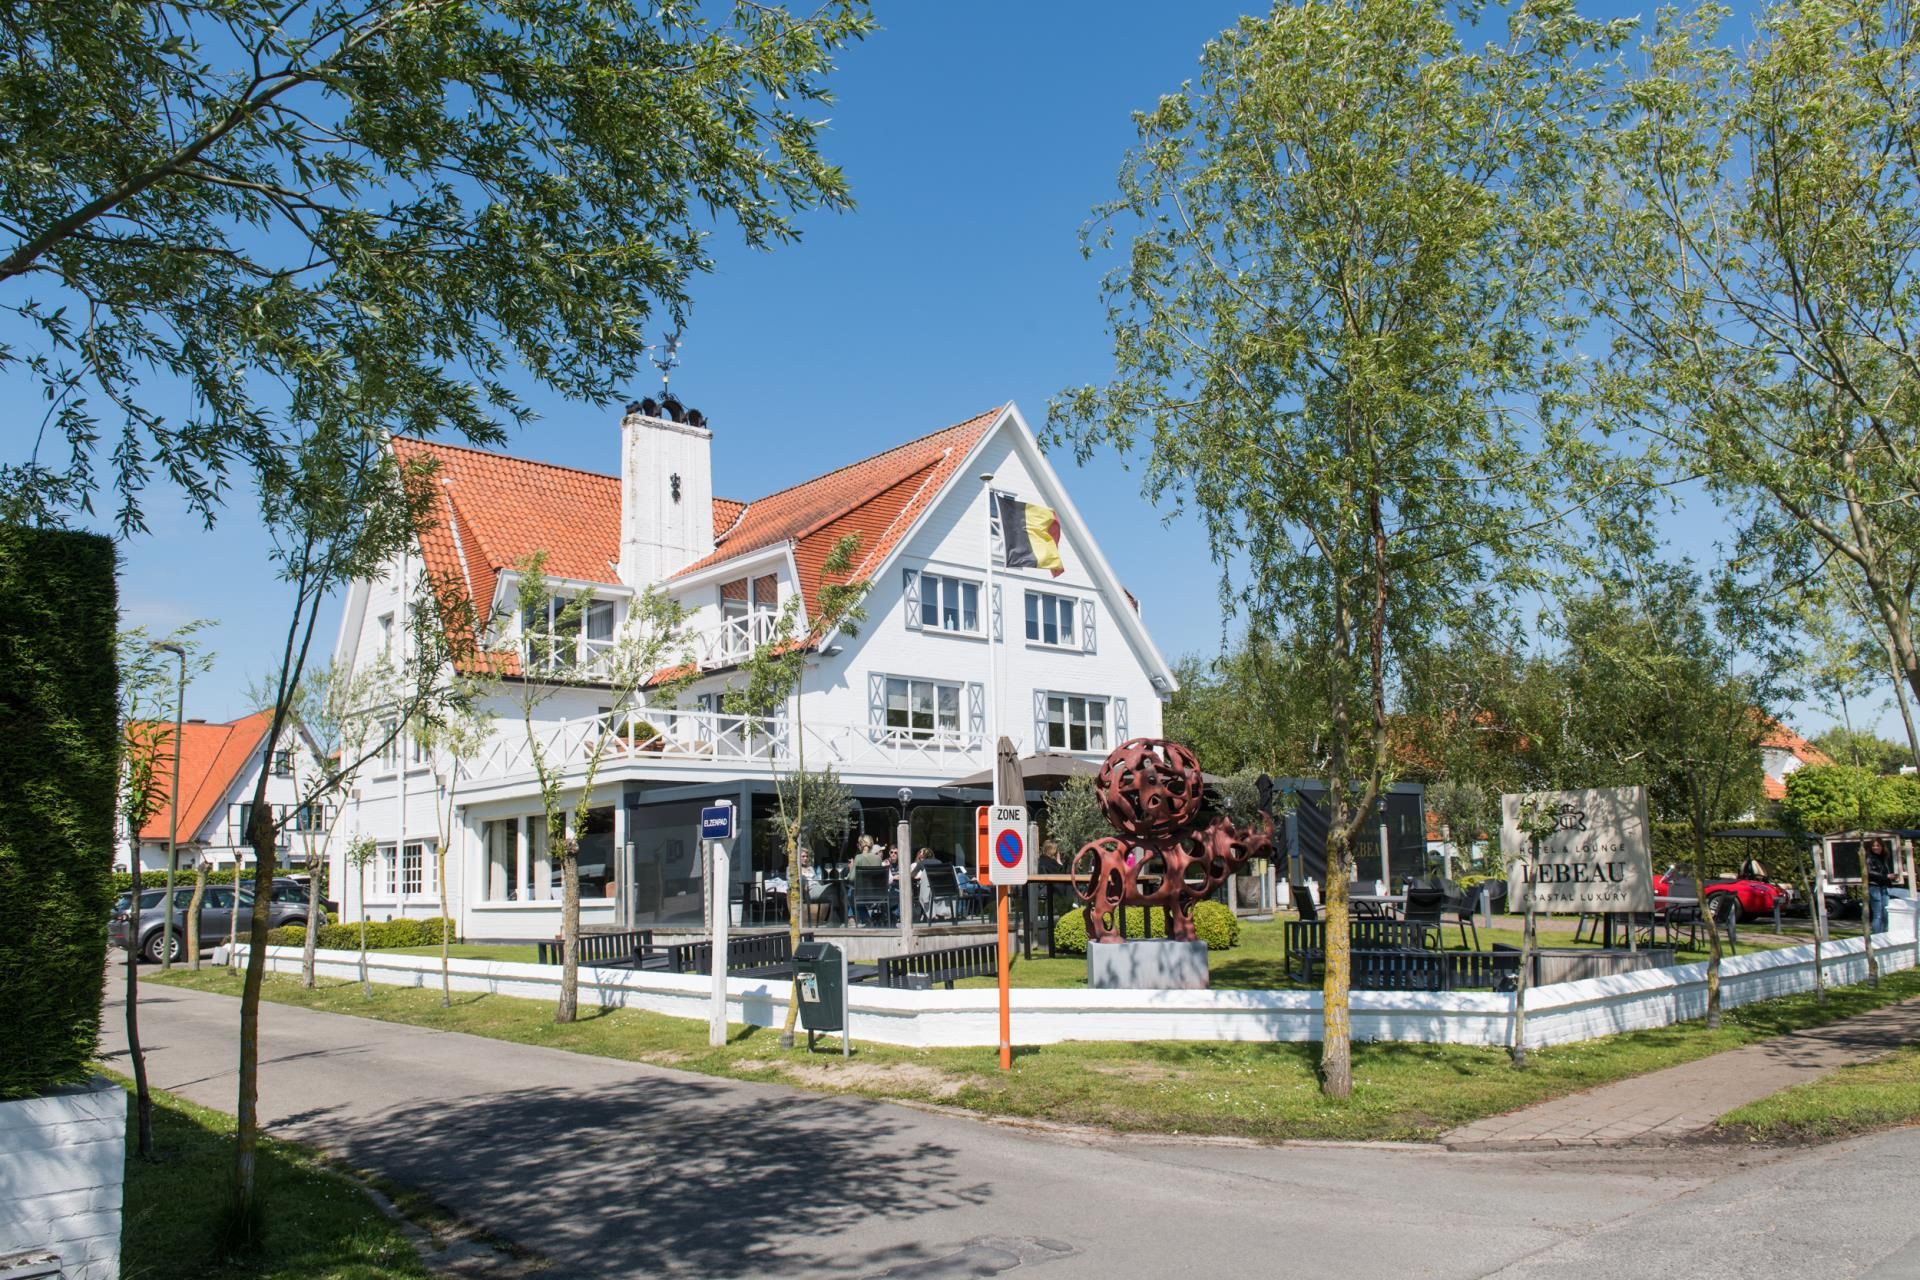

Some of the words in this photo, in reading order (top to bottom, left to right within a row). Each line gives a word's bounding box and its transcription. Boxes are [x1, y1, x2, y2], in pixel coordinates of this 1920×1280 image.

[997, 809, 1020, 821] ZONE
[1562, 845, 1568, 853] &
[1575, 843, 1625, 853] LOUNGE
[1580, 893, 1627, 901] LUXURY
